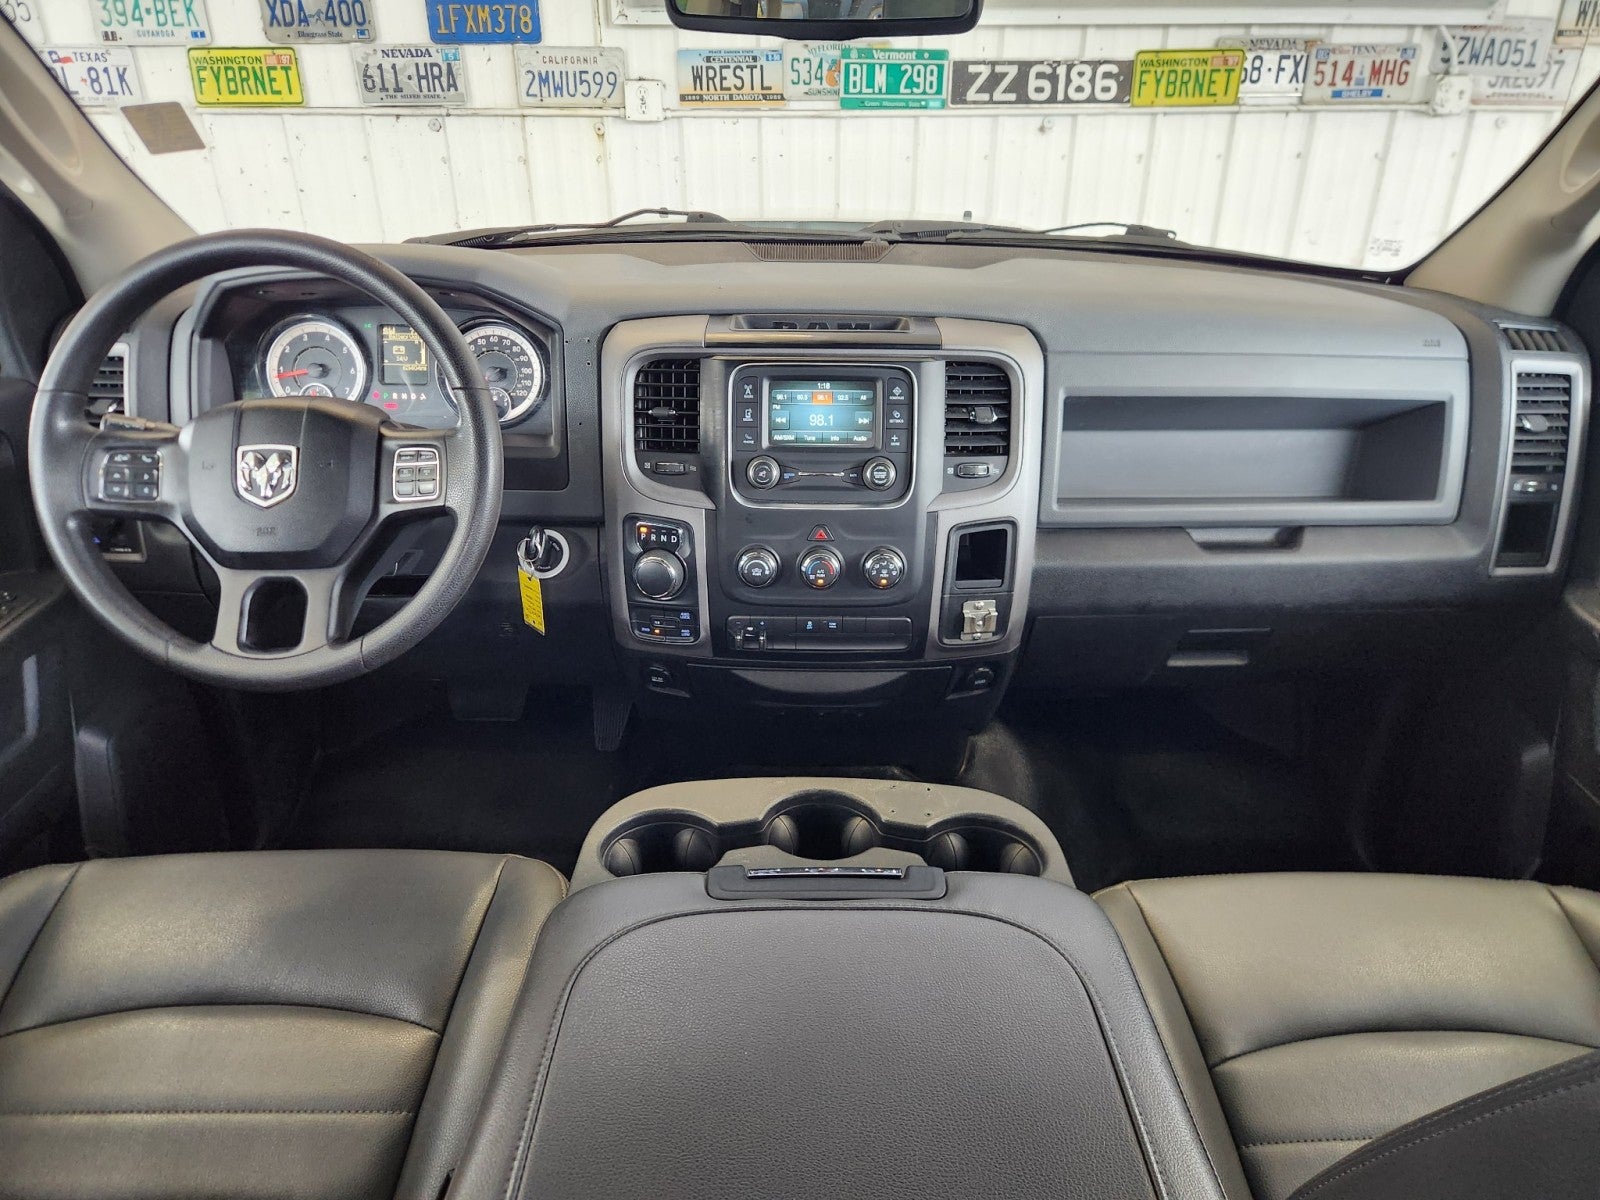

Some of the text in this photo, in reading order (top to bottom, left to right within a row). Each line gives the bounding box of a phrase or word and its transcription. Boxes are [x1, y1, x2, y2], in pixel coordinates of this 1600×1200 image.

[436, 4, 534, 35] 1FXM378
[136, 29, 176, 38] CUYAHOGA
[72, 51, 109, 63] TEXAS
[381, 48, 433, 59] NEVADA
[710, 55, 756, 63] CENTENNIAL
[873, 49, 917, 60] Vermont
[193, 56, 262, 66] WASHINGTON
[542, 55, 599, 65] CALIFORNIA
[1139, 57, 1209, 68] WASHINGTON
[196, 65, 294, 96] FYBRNET
[691, 64, 773, 91] WRESTL
[849, 64, 938, 94] BLM 298
[966, 63, 1120, 102] ZZ 6186
[1138, 68, 1236, 98] FYBRNET
[524, 69, 618, 98] 2MWU599
[702, 93, 730, 101] NORTH
[733, 93, 763, 101] DAKOTA
[477, 338, 487, 346] 50
[520, 367, 533, 375] 100
[809, 414, 834, 427] 98.1
[670, 535, 678, 543] D
